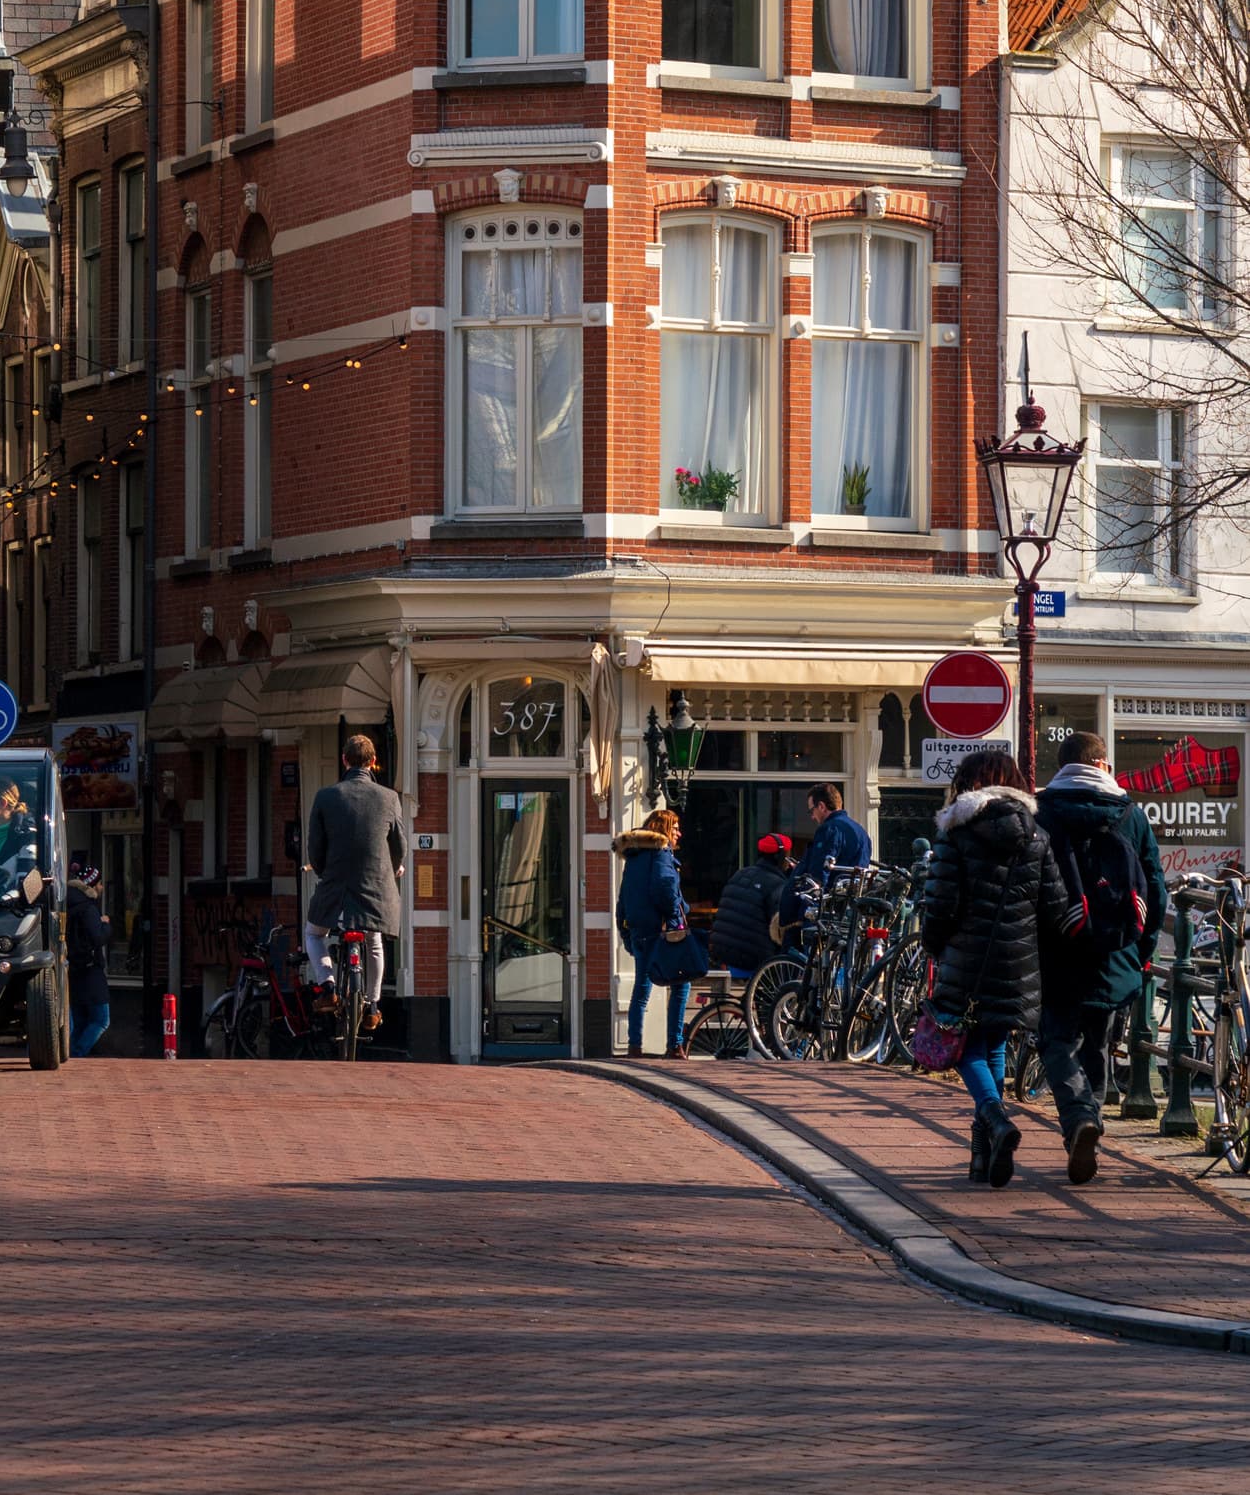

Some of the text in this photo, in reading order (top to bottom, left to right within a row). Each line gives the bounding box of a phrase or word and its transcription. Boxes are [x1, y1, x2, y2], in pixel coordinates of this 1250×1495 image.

[1033, 593, 1054, 605] NGEL
[1034, 605, 1054, 613] NTRUM
[493, 702, 557, 743] 387
[925, 742, 1009, 755] uitgezonderd
[1165, 828, 1227, 837] BY JAN PALMEN
